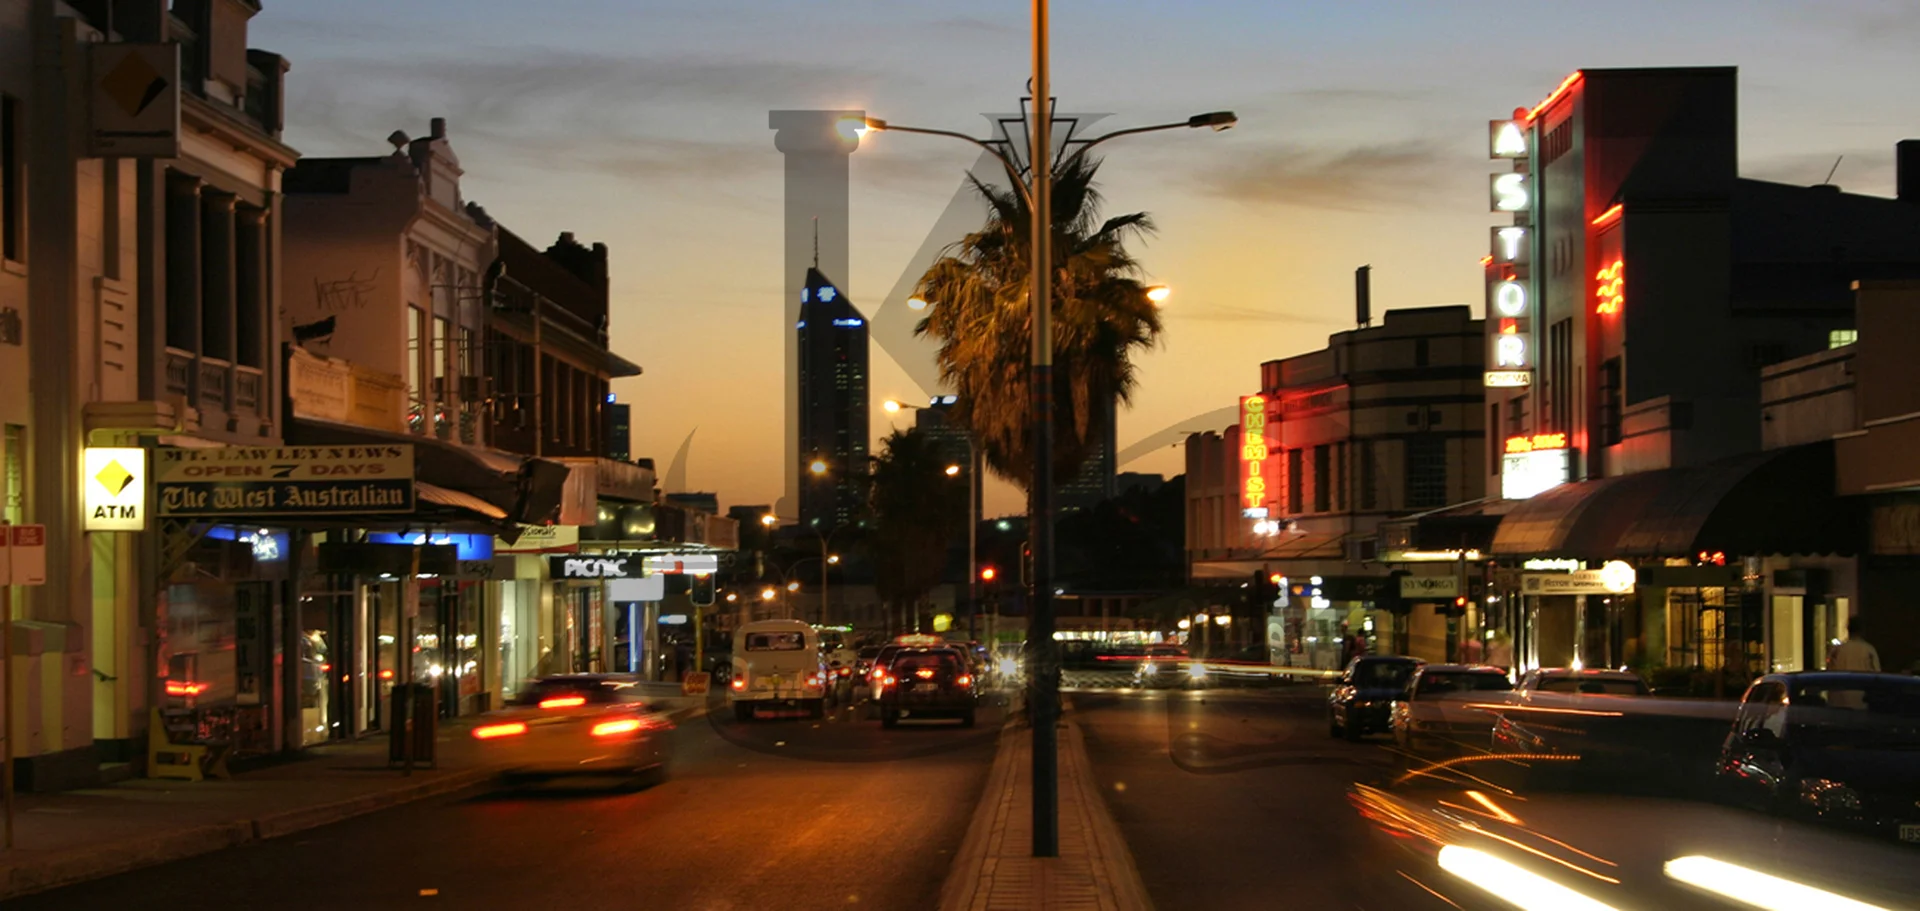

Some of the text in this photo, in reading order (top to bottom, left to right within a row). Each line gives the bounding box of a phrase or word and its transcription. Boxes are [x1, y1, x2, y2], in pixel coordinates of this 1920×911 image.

[1493, 120, 1529, 369] ASTOR
[163, 445, 403, 463] MT. LAWLEY NEWS
[1244, 395, 1268, 509] CHEMIST
[183, 462, 387, 478] OPEN 7 DAYS
[162, 482, 405, 510] The West Australian
[93, 504, 137, 520] ATM
[564, 558, 628, 578] PICNIC
